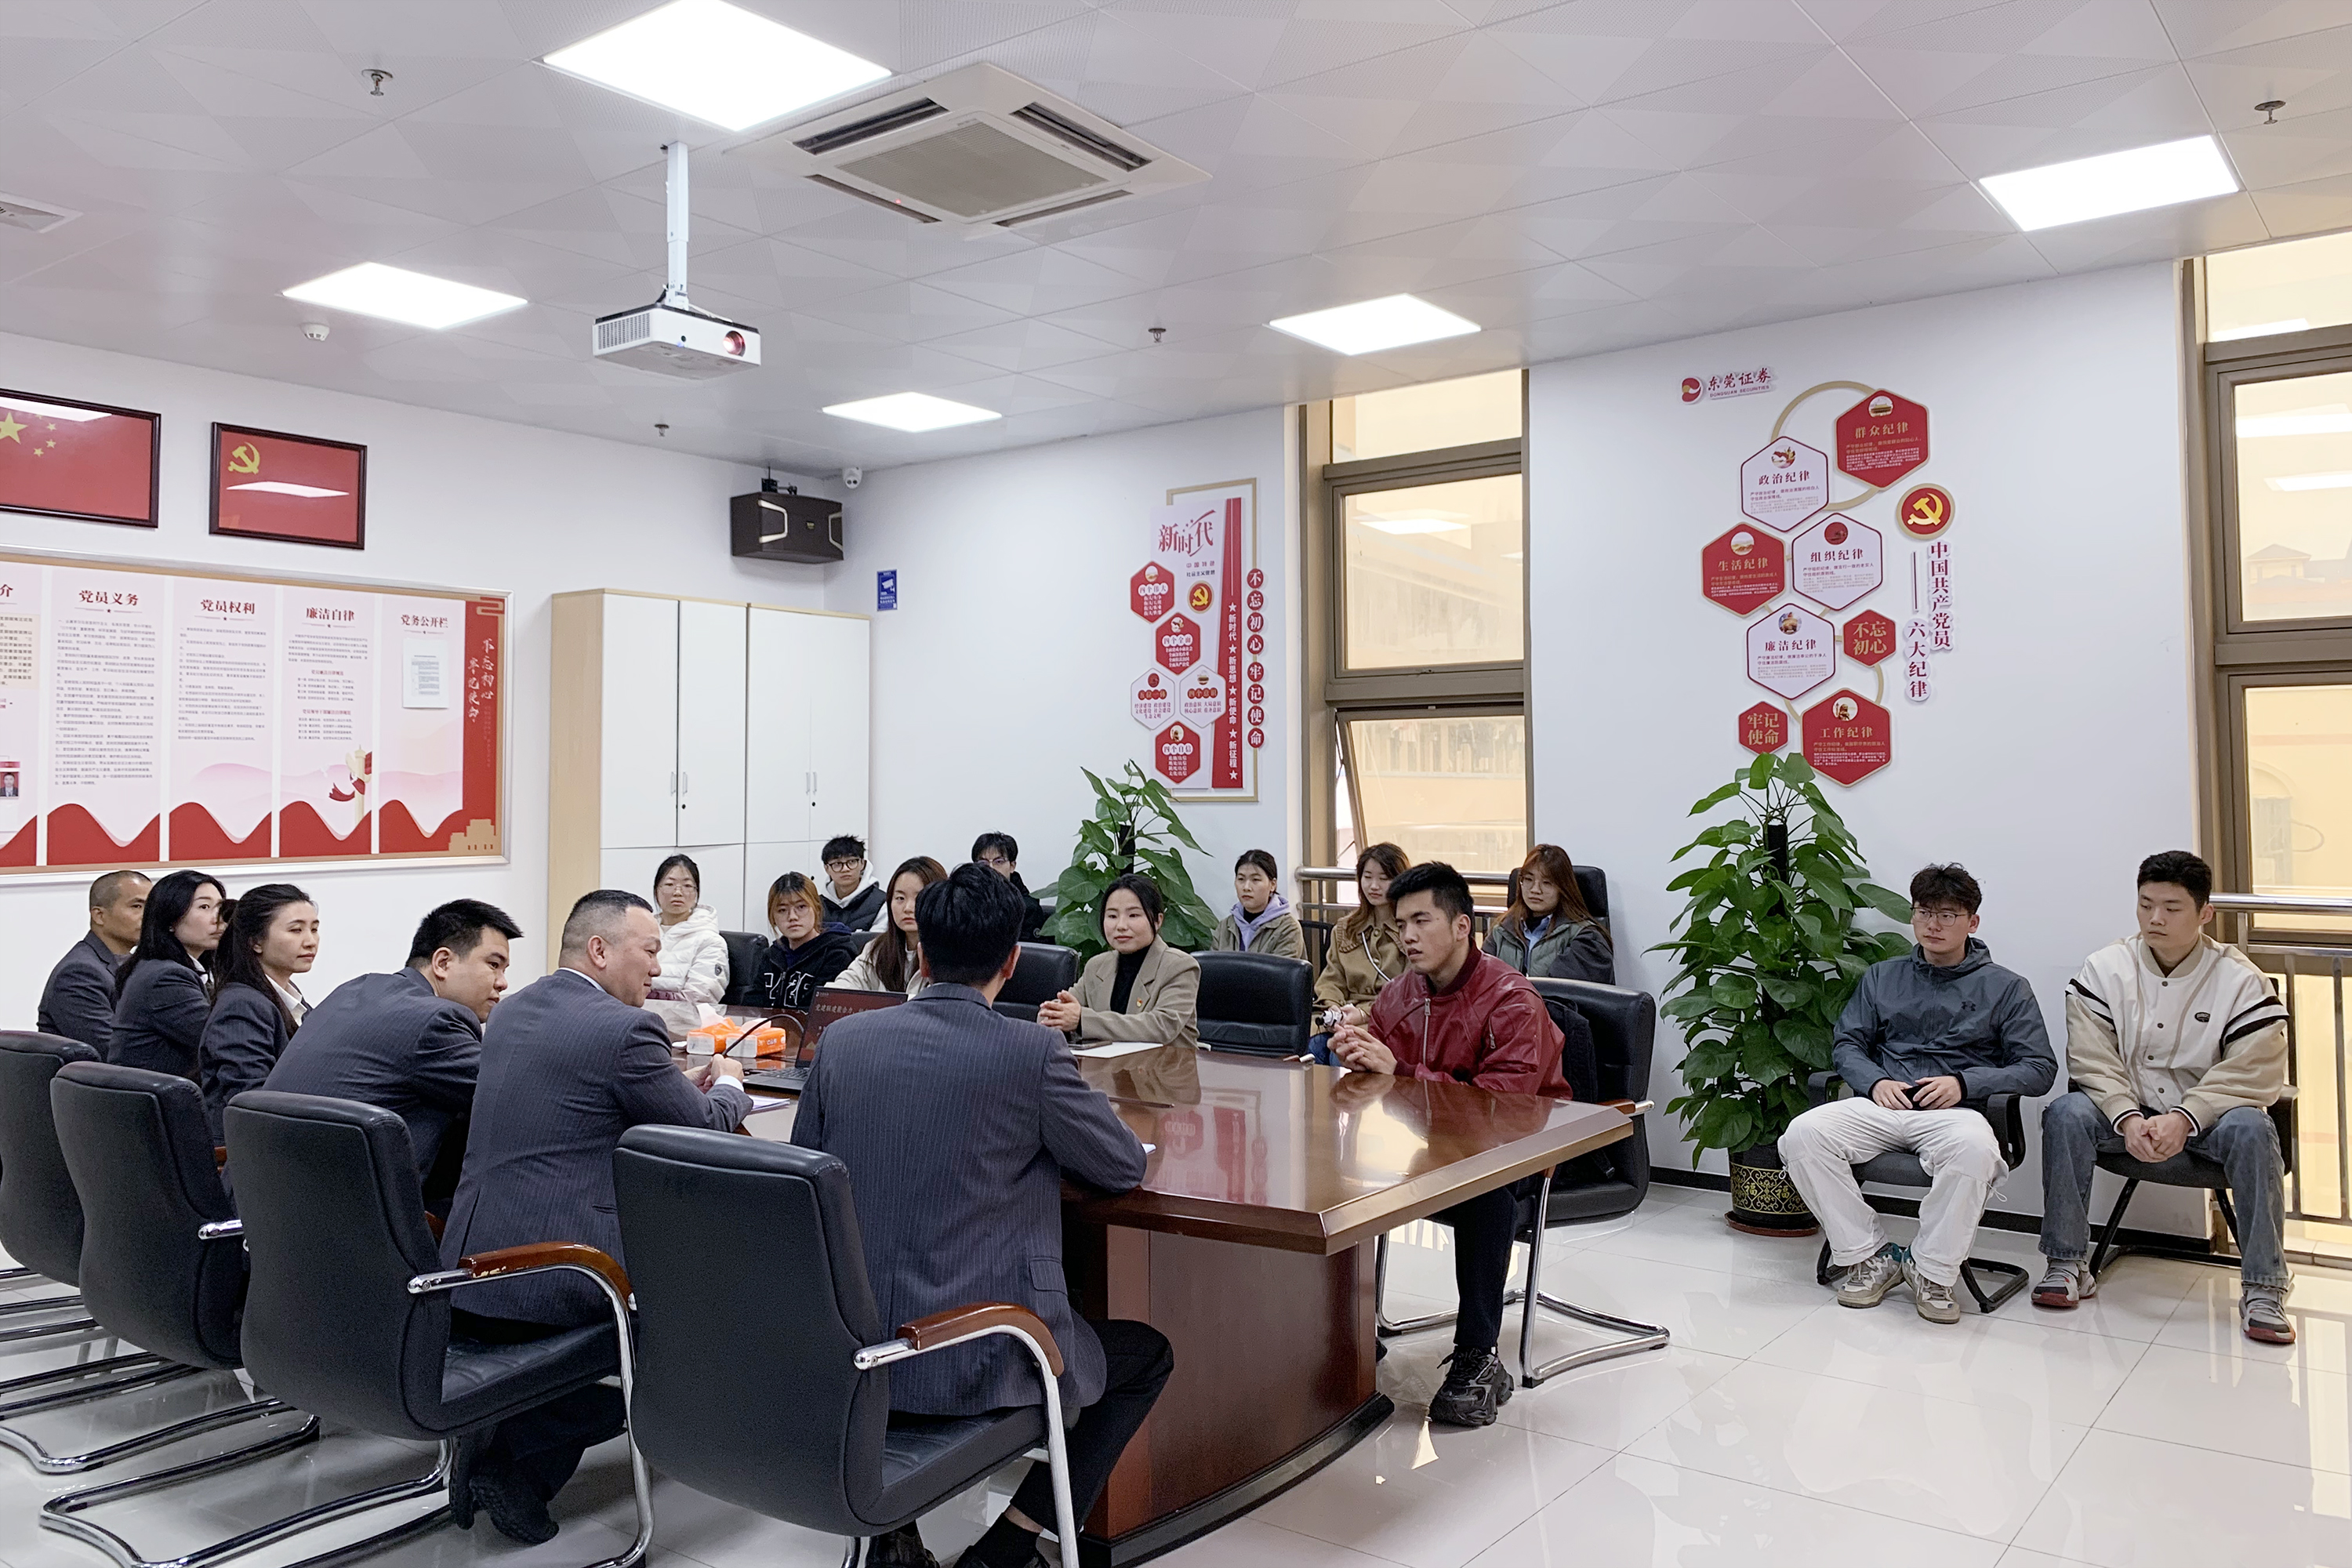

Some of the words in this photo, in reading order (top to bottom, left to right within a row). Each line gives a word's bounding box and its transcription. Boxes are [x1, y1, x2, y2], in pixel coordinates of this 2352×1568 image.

[1708, 367, 1771, 391] 东莞证券
[1740, 385, 1769, 394] SECURITIES
[1855, 422, 1908, 439] 群众纪律
[1759, 470, 1810, 486] 政治纪律
[1158, 509, 1216, 557] 新时代
[1810, 548, 1864, 562] 组织纪律
[1718, 557, 1768, 572] 生活纪律
[78, 590, 139, 606] 党员义务
[1930, 541, 1951, 648] 中国共产党员
[200, 599, 255, 615] 党员权利
[306, 607, 355, 622] 廉洁自律
[1249, 571, 1261, 652] 不忘初心
[401, 614, 448, 628] 党务公开栏
[1229, 614, 1237, 641] 新时代
[1853, 620, 1887, 638] 不忘
[1765, 639, 1817, 652] 廉洁纪律
[1853, 638, 1887, 656] 初心
[1907, 622, 1928, 698] 六大纪律
[1229, 656, 1237, 683] 新思想
[1229, 698, 1237, 724] 新使命
[1249, 664, 1261, 745] 牢记使命
[1747, 712, 1780, 729] 牢记
[1747, 729, 1780, 746] 使命
[1820, 726, 1873, 739] 工作纪律
[1229, 741, 1237, 768] 新征程
[1744, 1181, 1758, 1196] 福
[1775, 1185, 1791, 1199] 福
